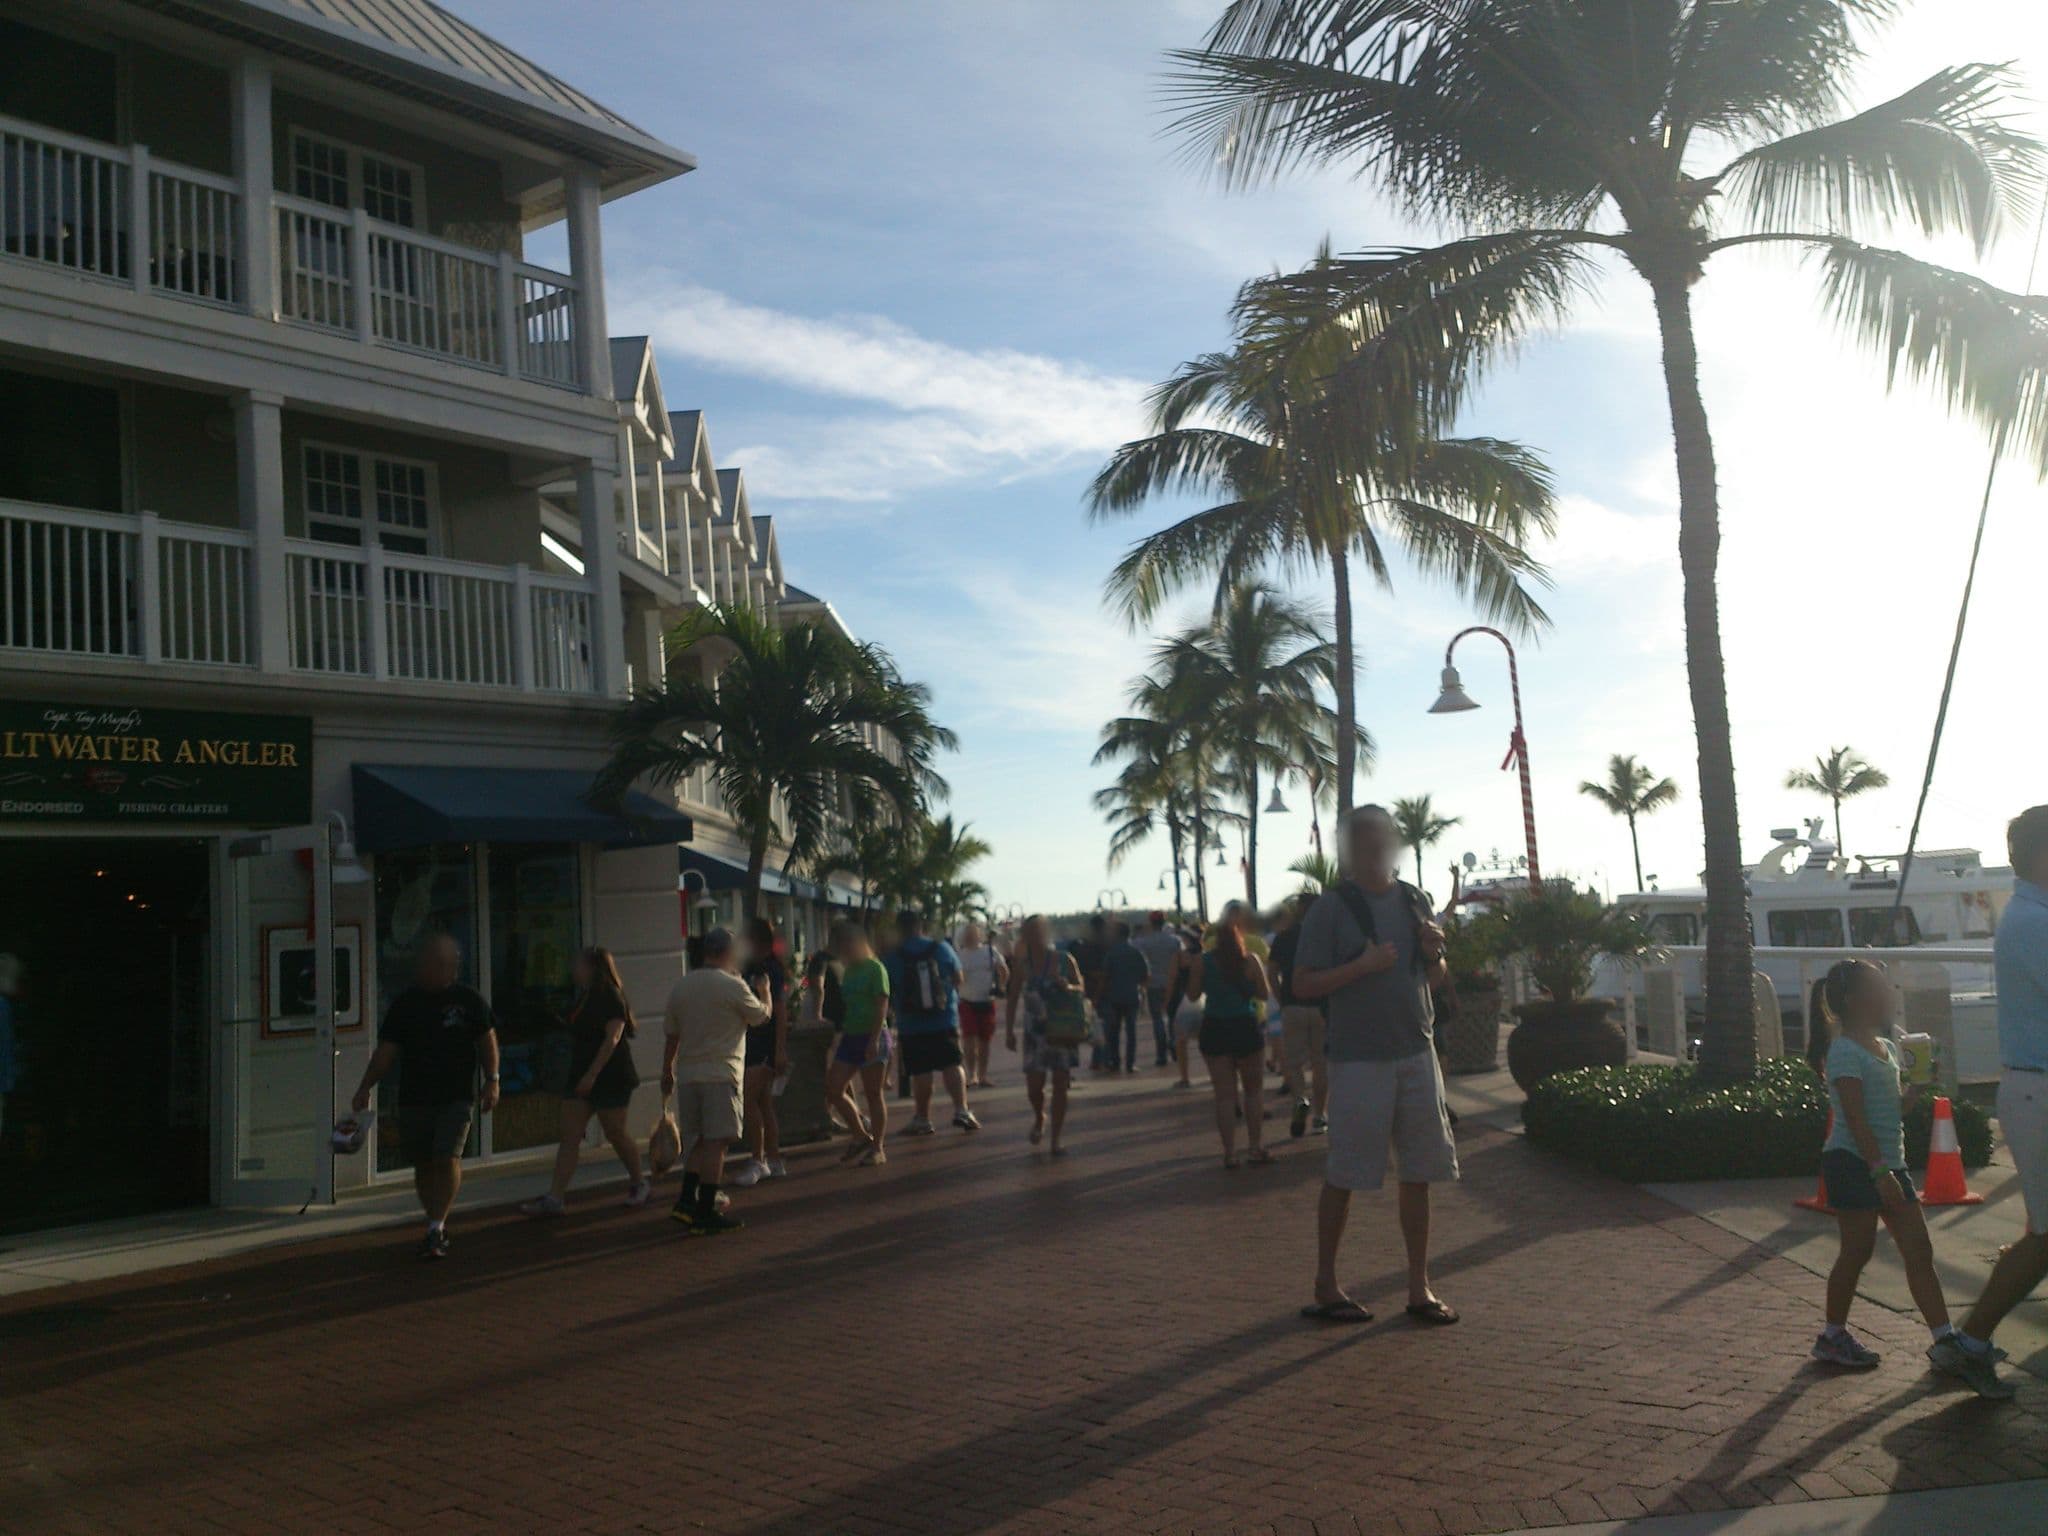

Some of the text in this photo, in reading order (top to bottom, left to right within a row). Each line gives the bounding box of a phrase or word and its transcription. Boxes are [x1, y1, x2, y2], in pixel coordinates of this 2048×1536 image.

[0, 731, 299, 767] LTWATER ANGLER
[0, 800, 84, 814] ENDORSED
[119, 801, 229, 814] FISHING CHARTERS
